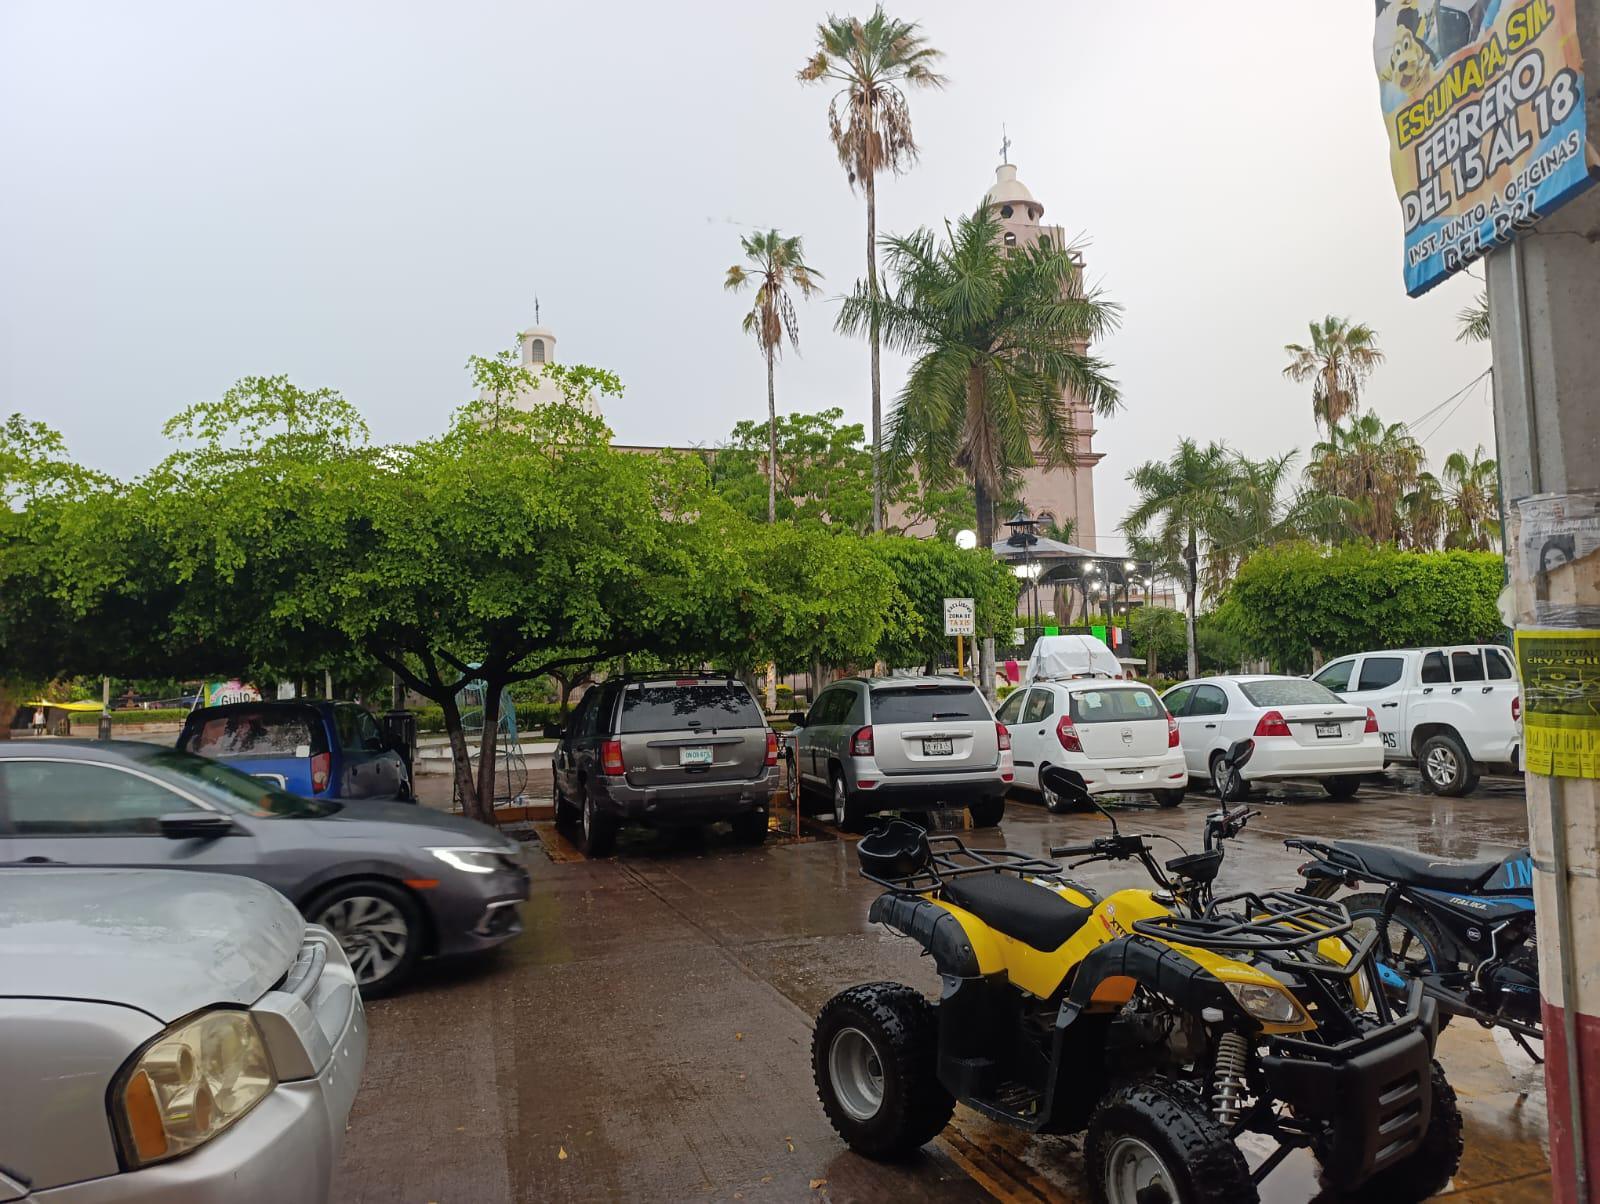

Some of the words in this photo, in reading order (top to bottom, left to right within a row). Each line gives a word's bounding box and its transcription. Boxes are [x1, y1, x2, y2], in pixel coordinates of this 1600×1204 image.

[1402, 176, 1449, 231] DEL
[1453, 147, 1483, 196] 15
[1488, 116, 1530, 174] AL
[1535, 72, 1574, 134] 18
[1418, 53, 1542, 180] FEBRERO
[1440, 203, 1485, 247] JUNTO
[1489, 194, 1501, 214] A
[1505, 133, 1579, 201] OFICINAS
[1379, 732, 1397, 748] AS
